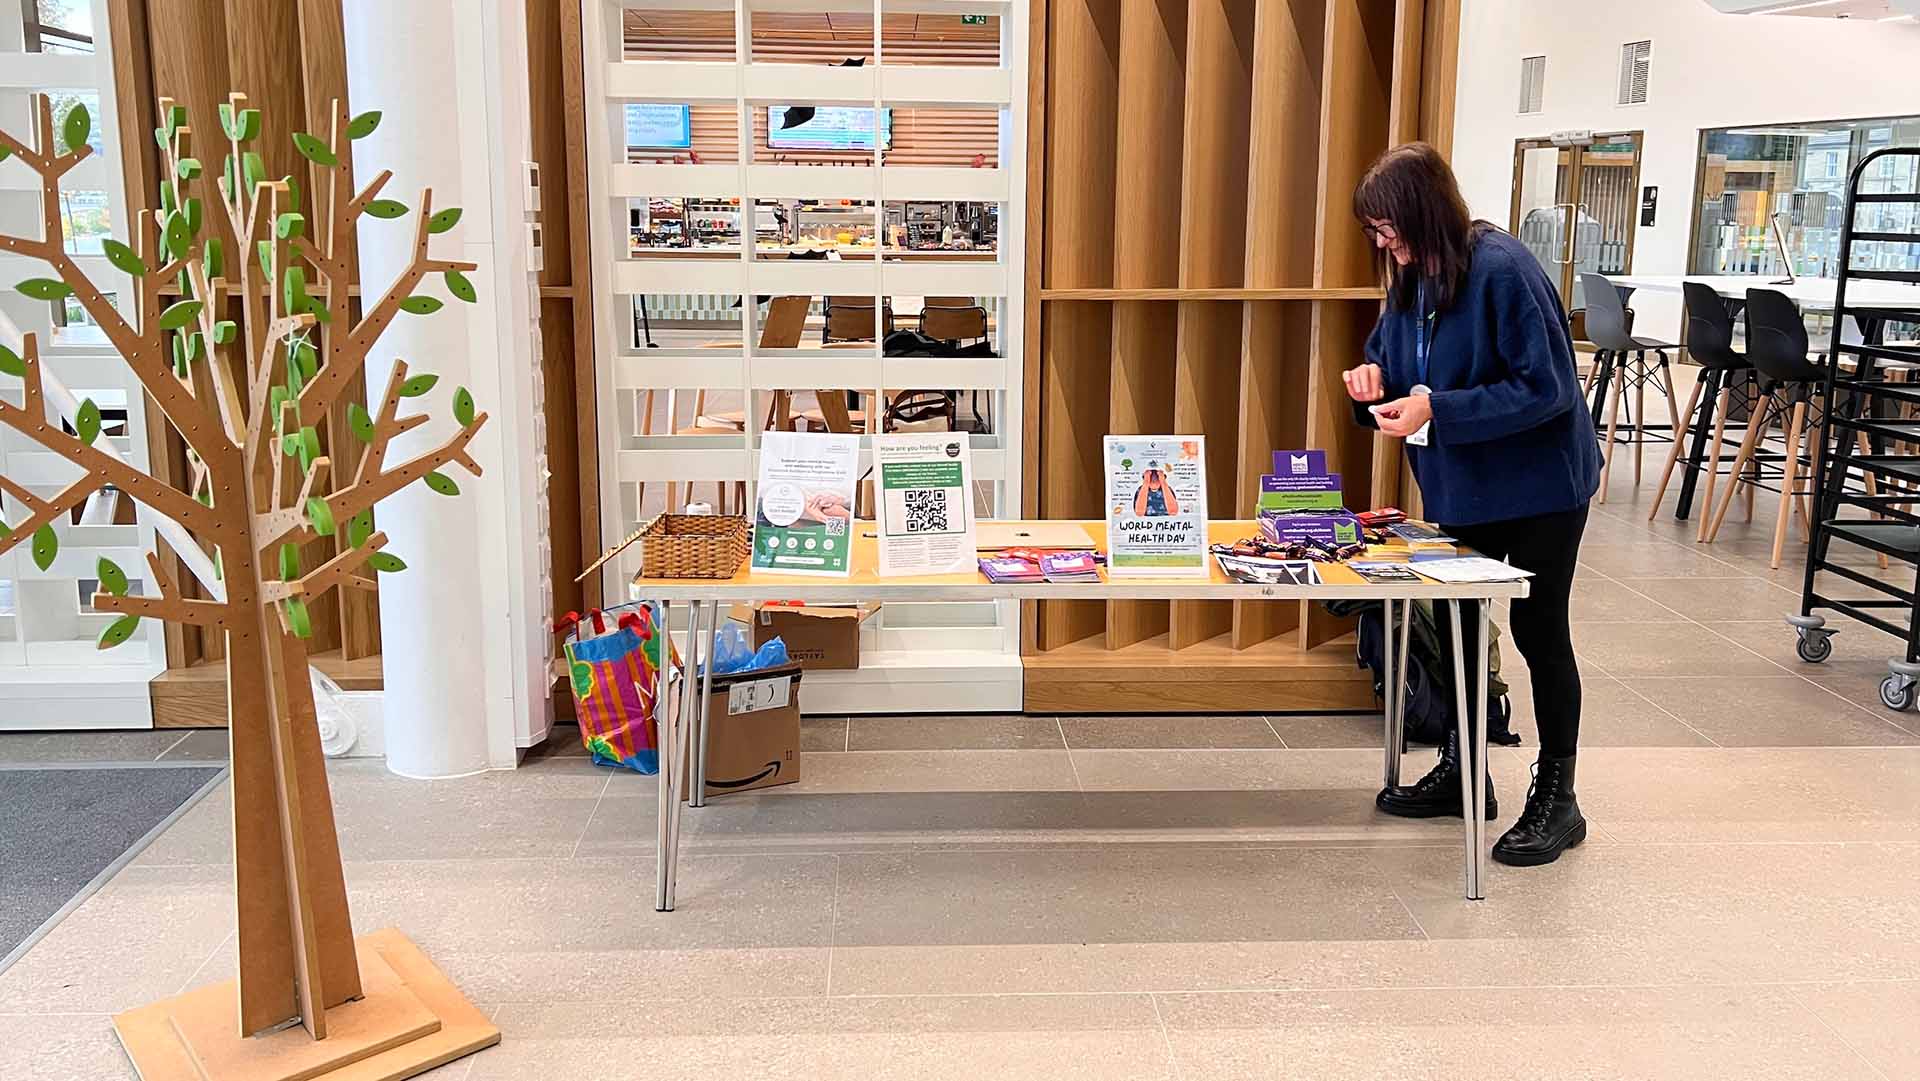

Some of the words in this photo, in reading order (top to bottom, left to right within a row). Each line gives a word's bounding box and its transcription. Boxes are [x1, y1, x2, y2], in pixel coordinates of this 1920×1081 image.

[1119, 521, 1153, 531] WORLD
[1155, 521, 1194, 531] MENTAL
[1128, 533, 1165, 543] HEALTH
[1166, 533, 1186, 543] DAY
